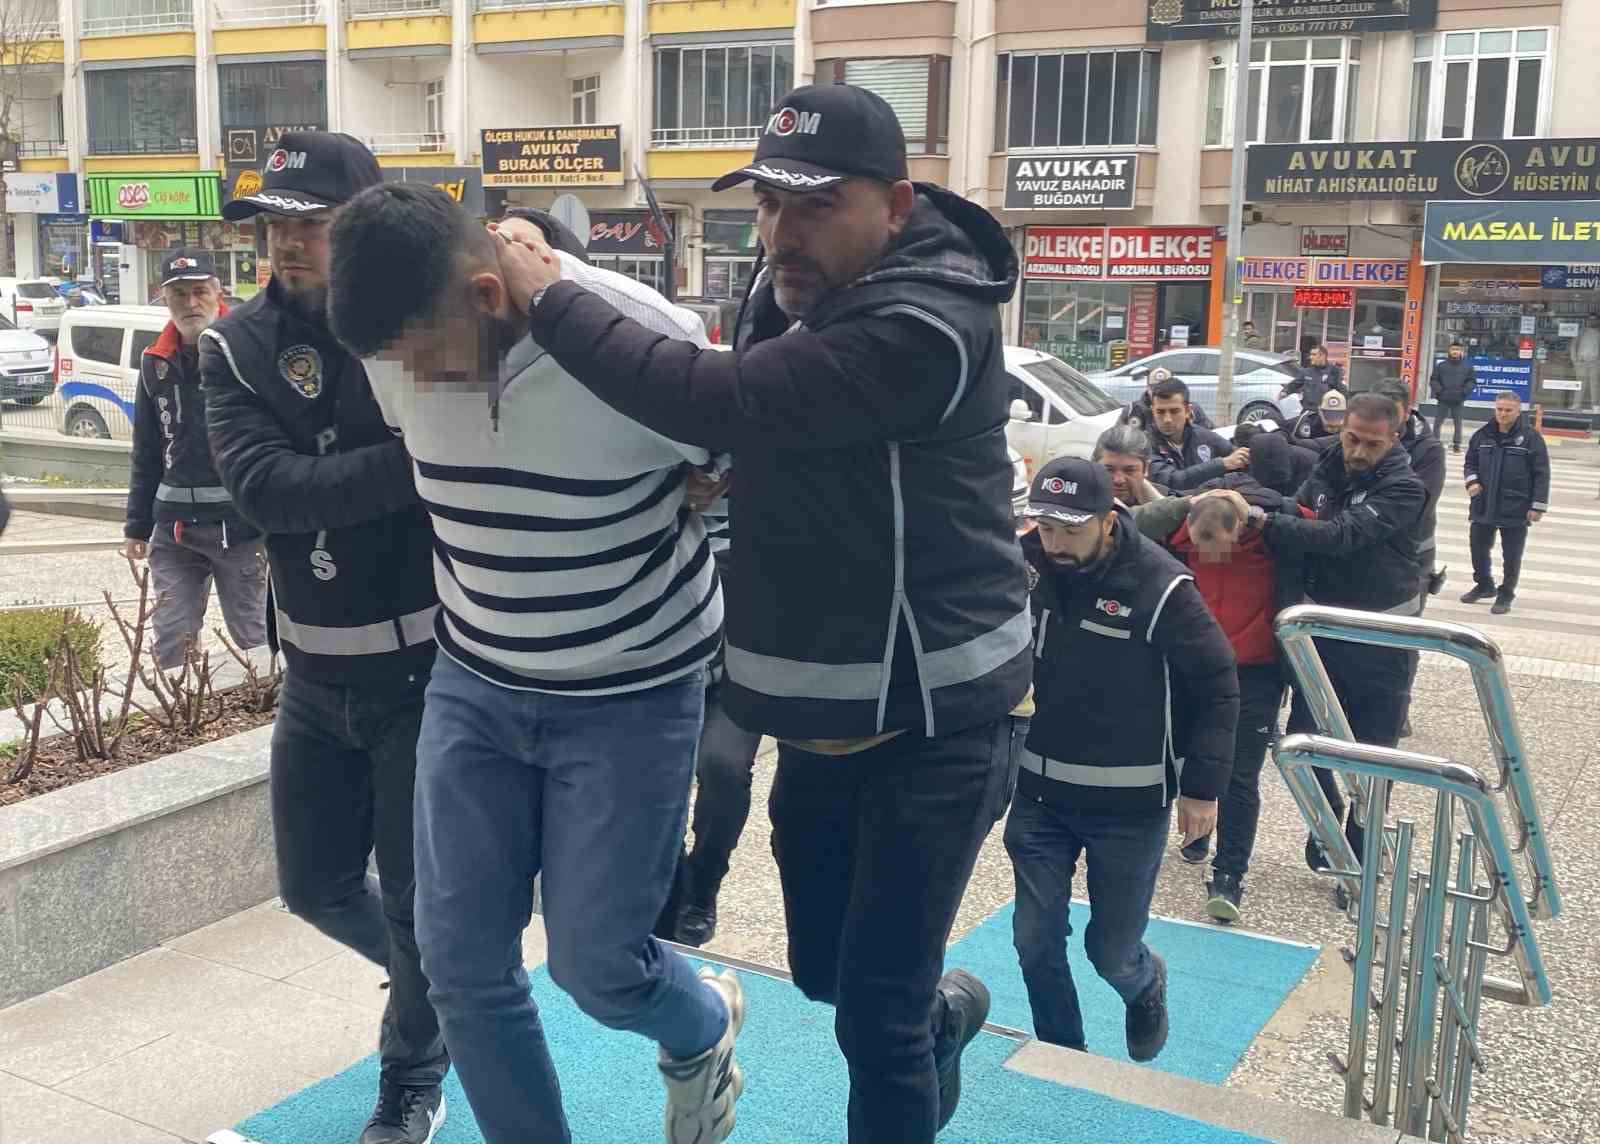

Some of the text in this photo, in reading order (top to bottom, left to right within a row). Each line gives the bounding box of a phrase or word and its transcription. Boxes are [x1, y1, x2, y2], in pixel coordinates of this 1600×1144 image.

[484, 128, 617, 144] ÖLÇER HUKUK & DANIŞMANLIK
[521, 143, 579, 155] AVUKAT
[499, 156, 604, 172] BURAK ÖLÇER
[1016, 159, 1128, 177] AVUKAT
[1288, 149, 1418, 171] AVUKAT
[1016, 178, 1126, 192] YAVUZ BAHADIR
[1265, 173, 1439, 194] NİHAT AHISKALIOĞLU
[1513, 172, 1589, 191] HÜSEYİN
[1034, 192, 1104, 206] BUĞDAYLI
[1442, 222, 1544, 241] MASAL
[1027, 264, 1064, 274] ARZUHAL
[1111, 265, 1163, 276] ARZUHAL
[1041, 476, 1078, 496] KOM
